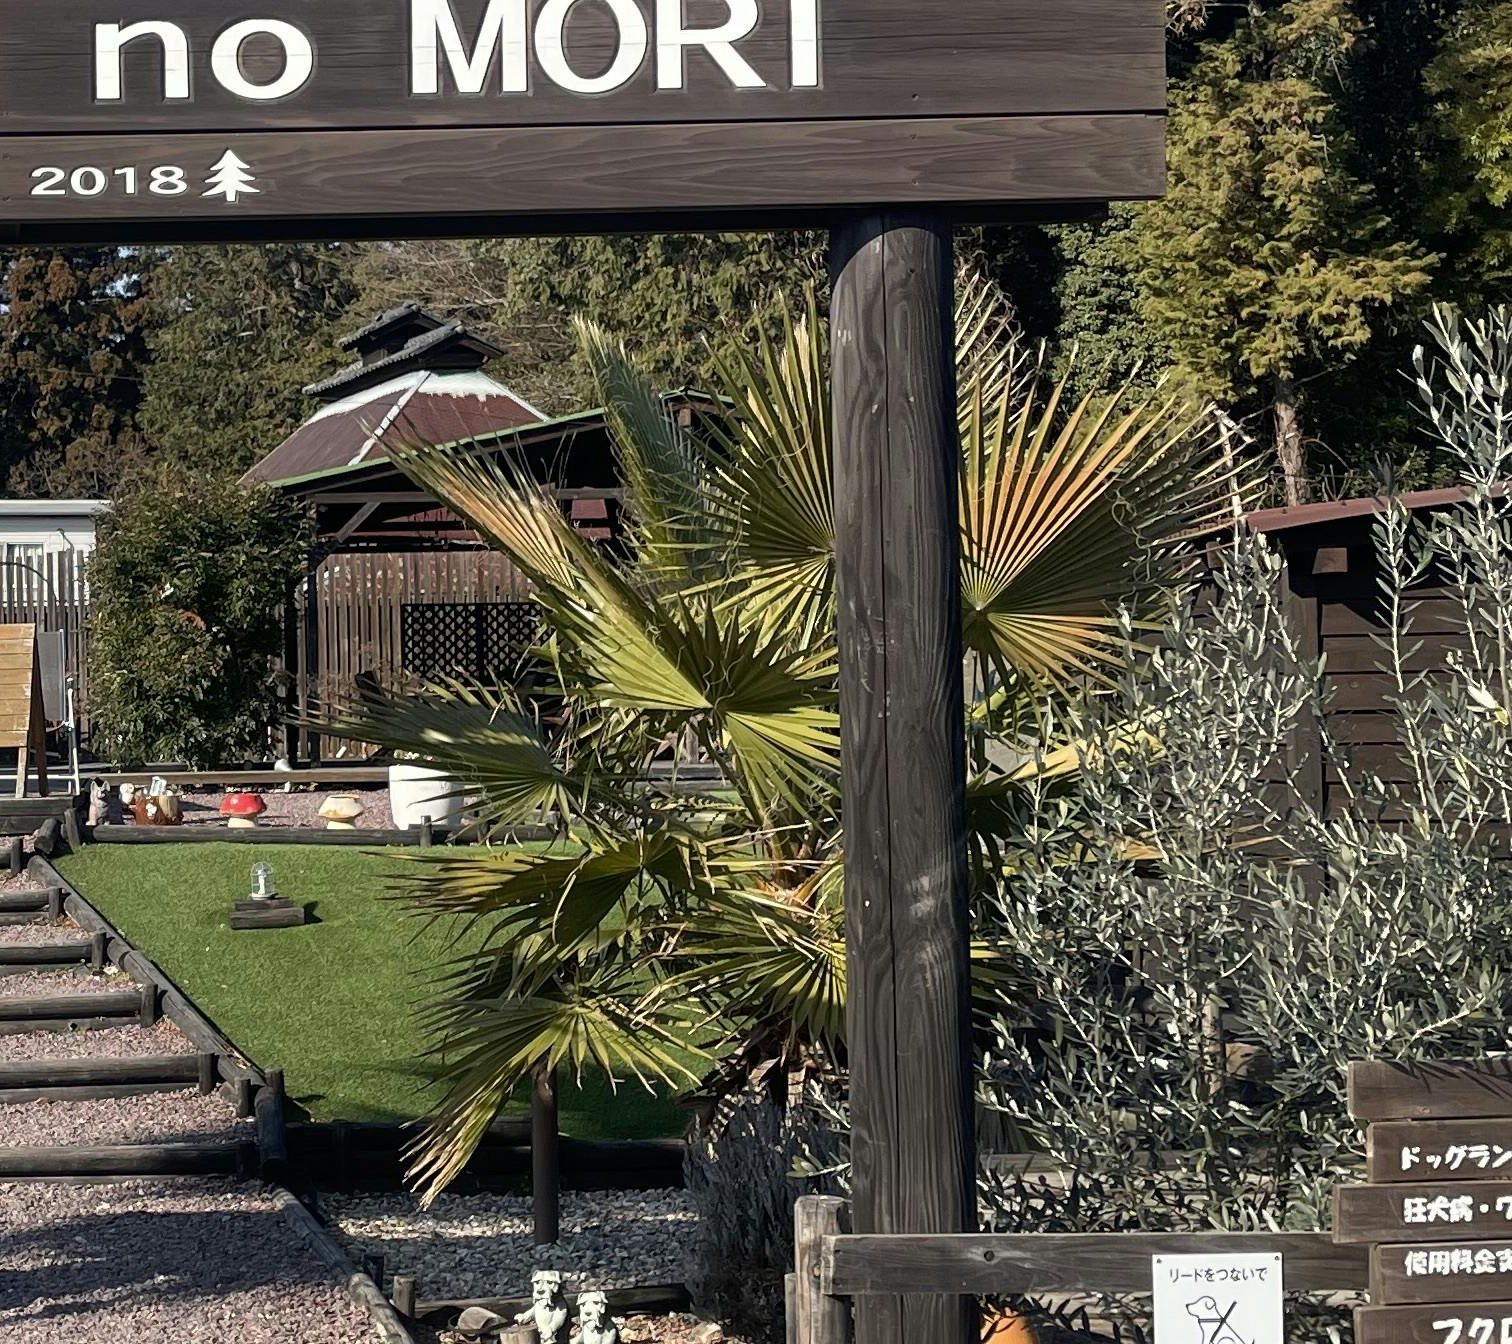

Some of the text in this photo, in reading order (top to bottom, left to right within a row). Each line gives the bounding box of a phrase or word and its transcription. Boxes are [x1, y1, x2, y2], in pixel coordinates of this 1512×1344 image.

[94, 18, 314, 101] no
[30, 164, 189, 198] 2018
[1401, 1144, 1512, 1171] ドッグラン
[1169, 1267, 1268, 1283] リードをつないで
